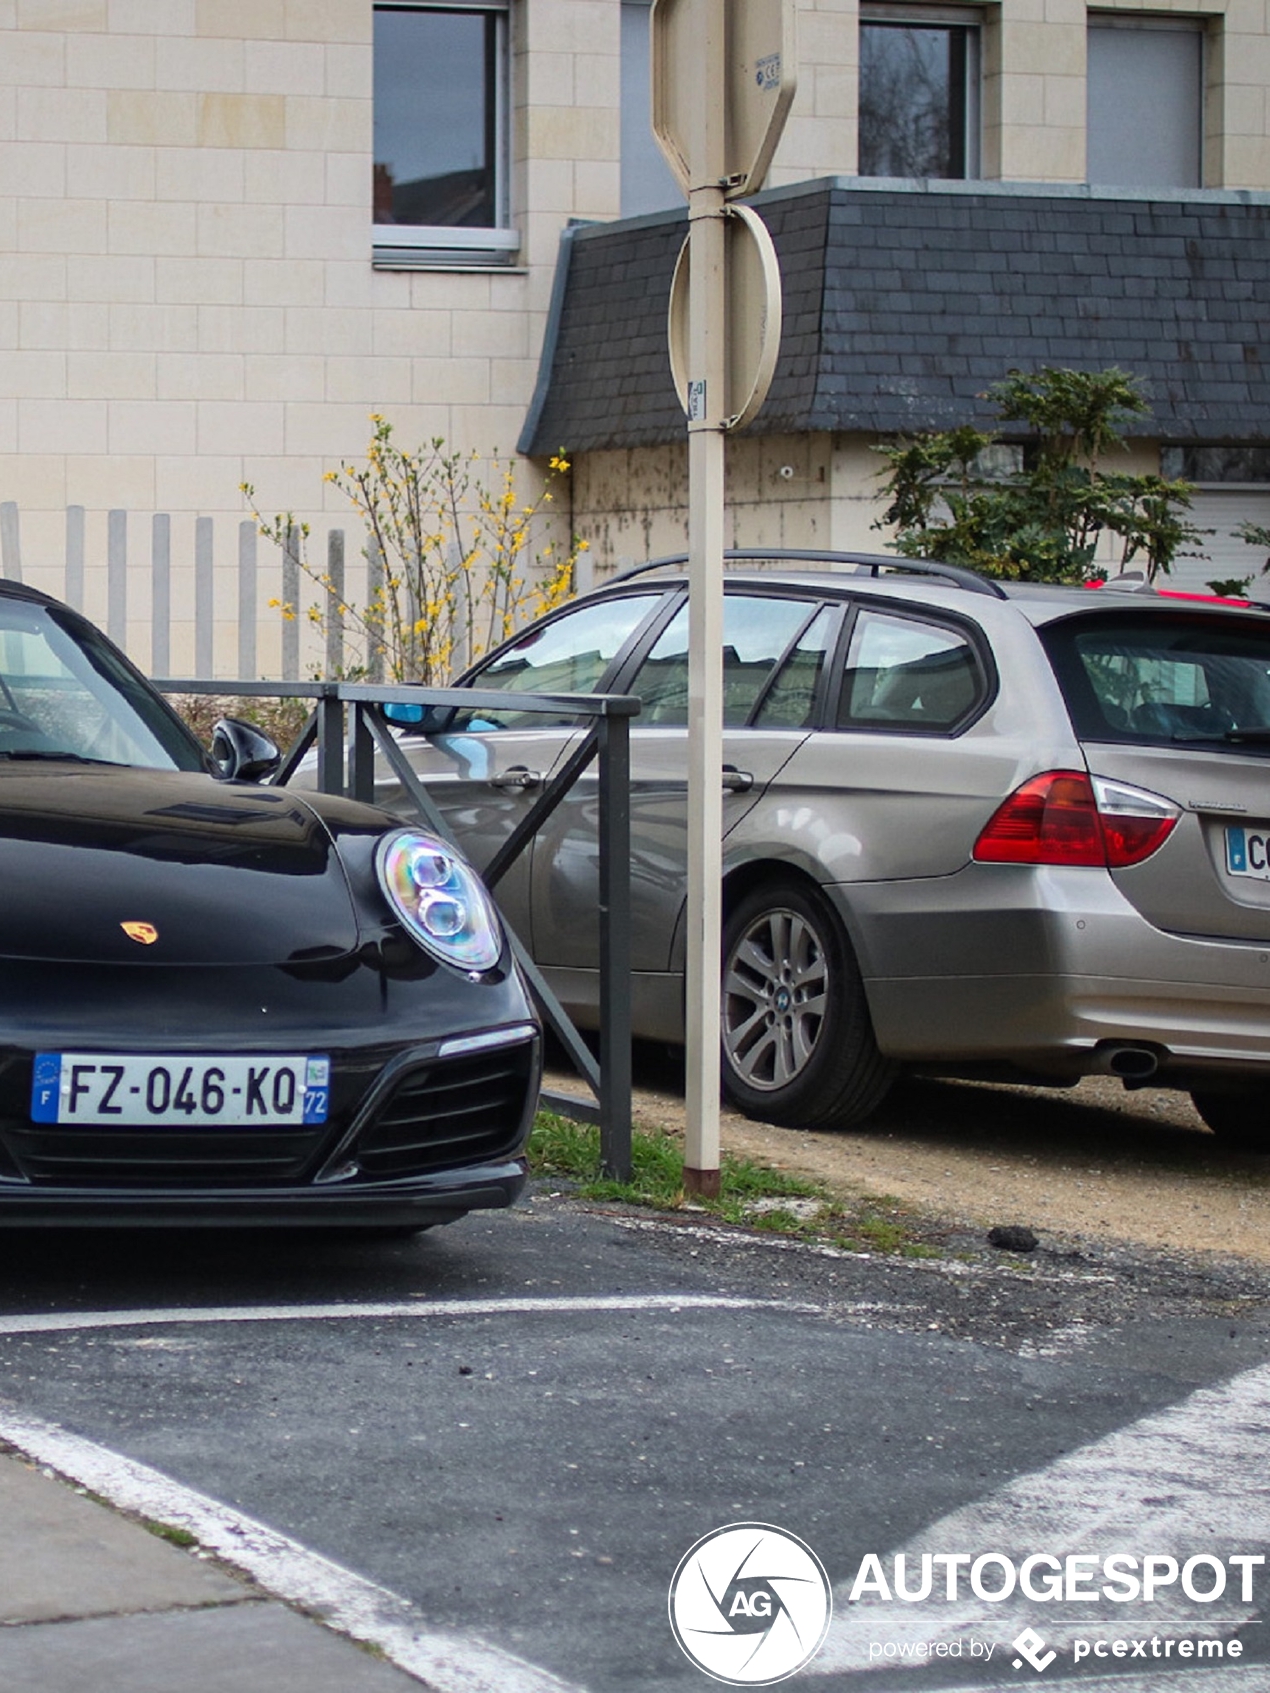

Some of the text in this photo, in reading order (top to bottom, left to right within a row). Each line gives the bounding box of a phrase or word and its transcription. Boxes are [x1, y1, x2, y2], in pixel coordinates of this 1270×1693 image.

[1248, 835, 1270, 870] C
[41, 1090, 51, 1105] F
[68, 1065, 296, 1115] FZ-046-KQ
[305, 1091, 327, 1114] 72
